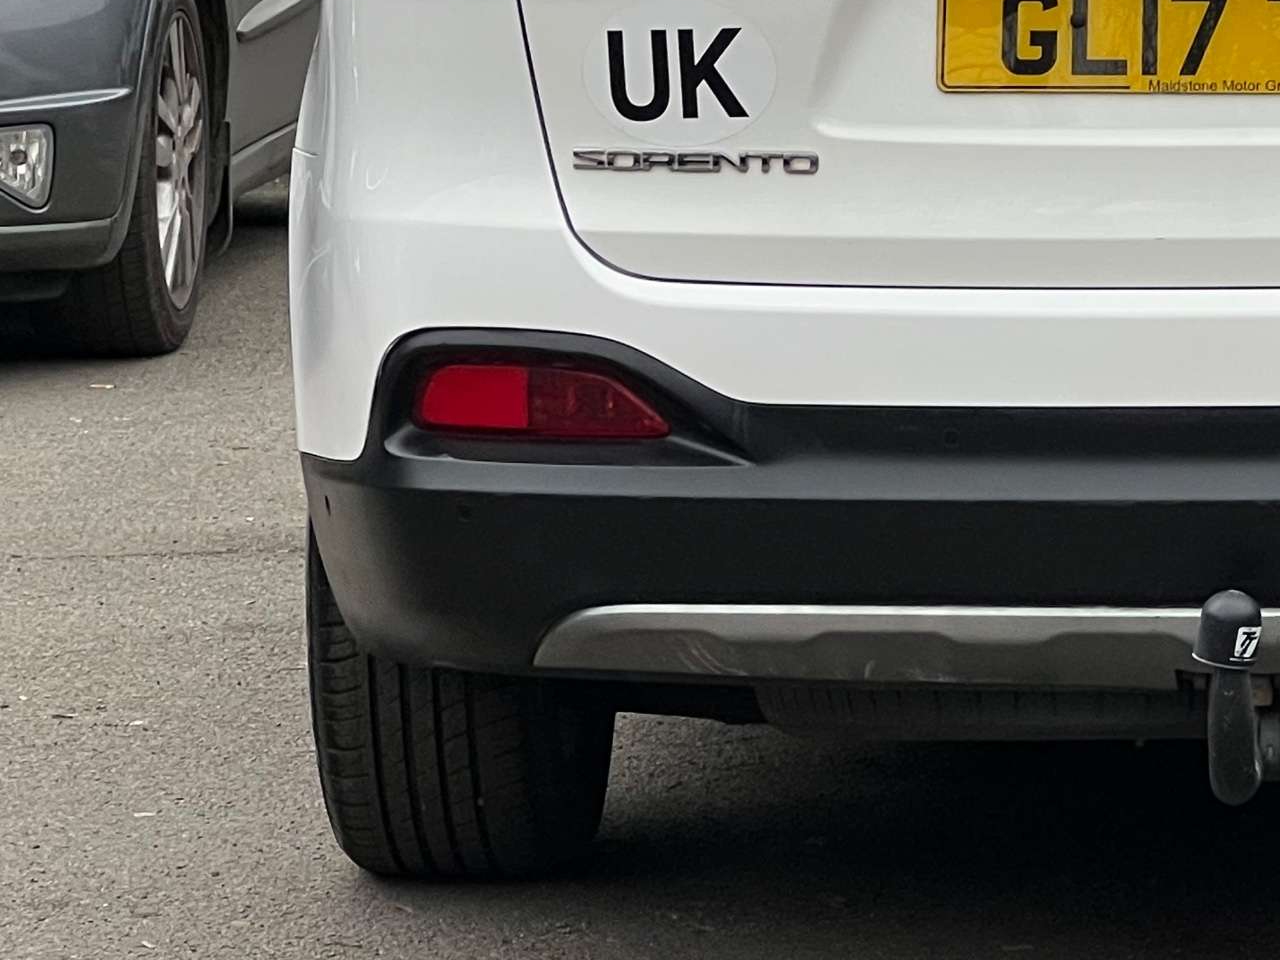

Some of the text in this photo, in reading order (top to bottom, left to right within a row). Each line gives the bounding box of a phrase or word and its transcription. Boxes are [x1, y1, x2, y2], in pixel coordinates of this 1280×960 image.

[606, 27, 750, 122] UK
[1148, 79, 1218, 91] Maidstone
[1222, 79, 1260, 91] Motor
[573, 149, 819, 174] SORENTO
